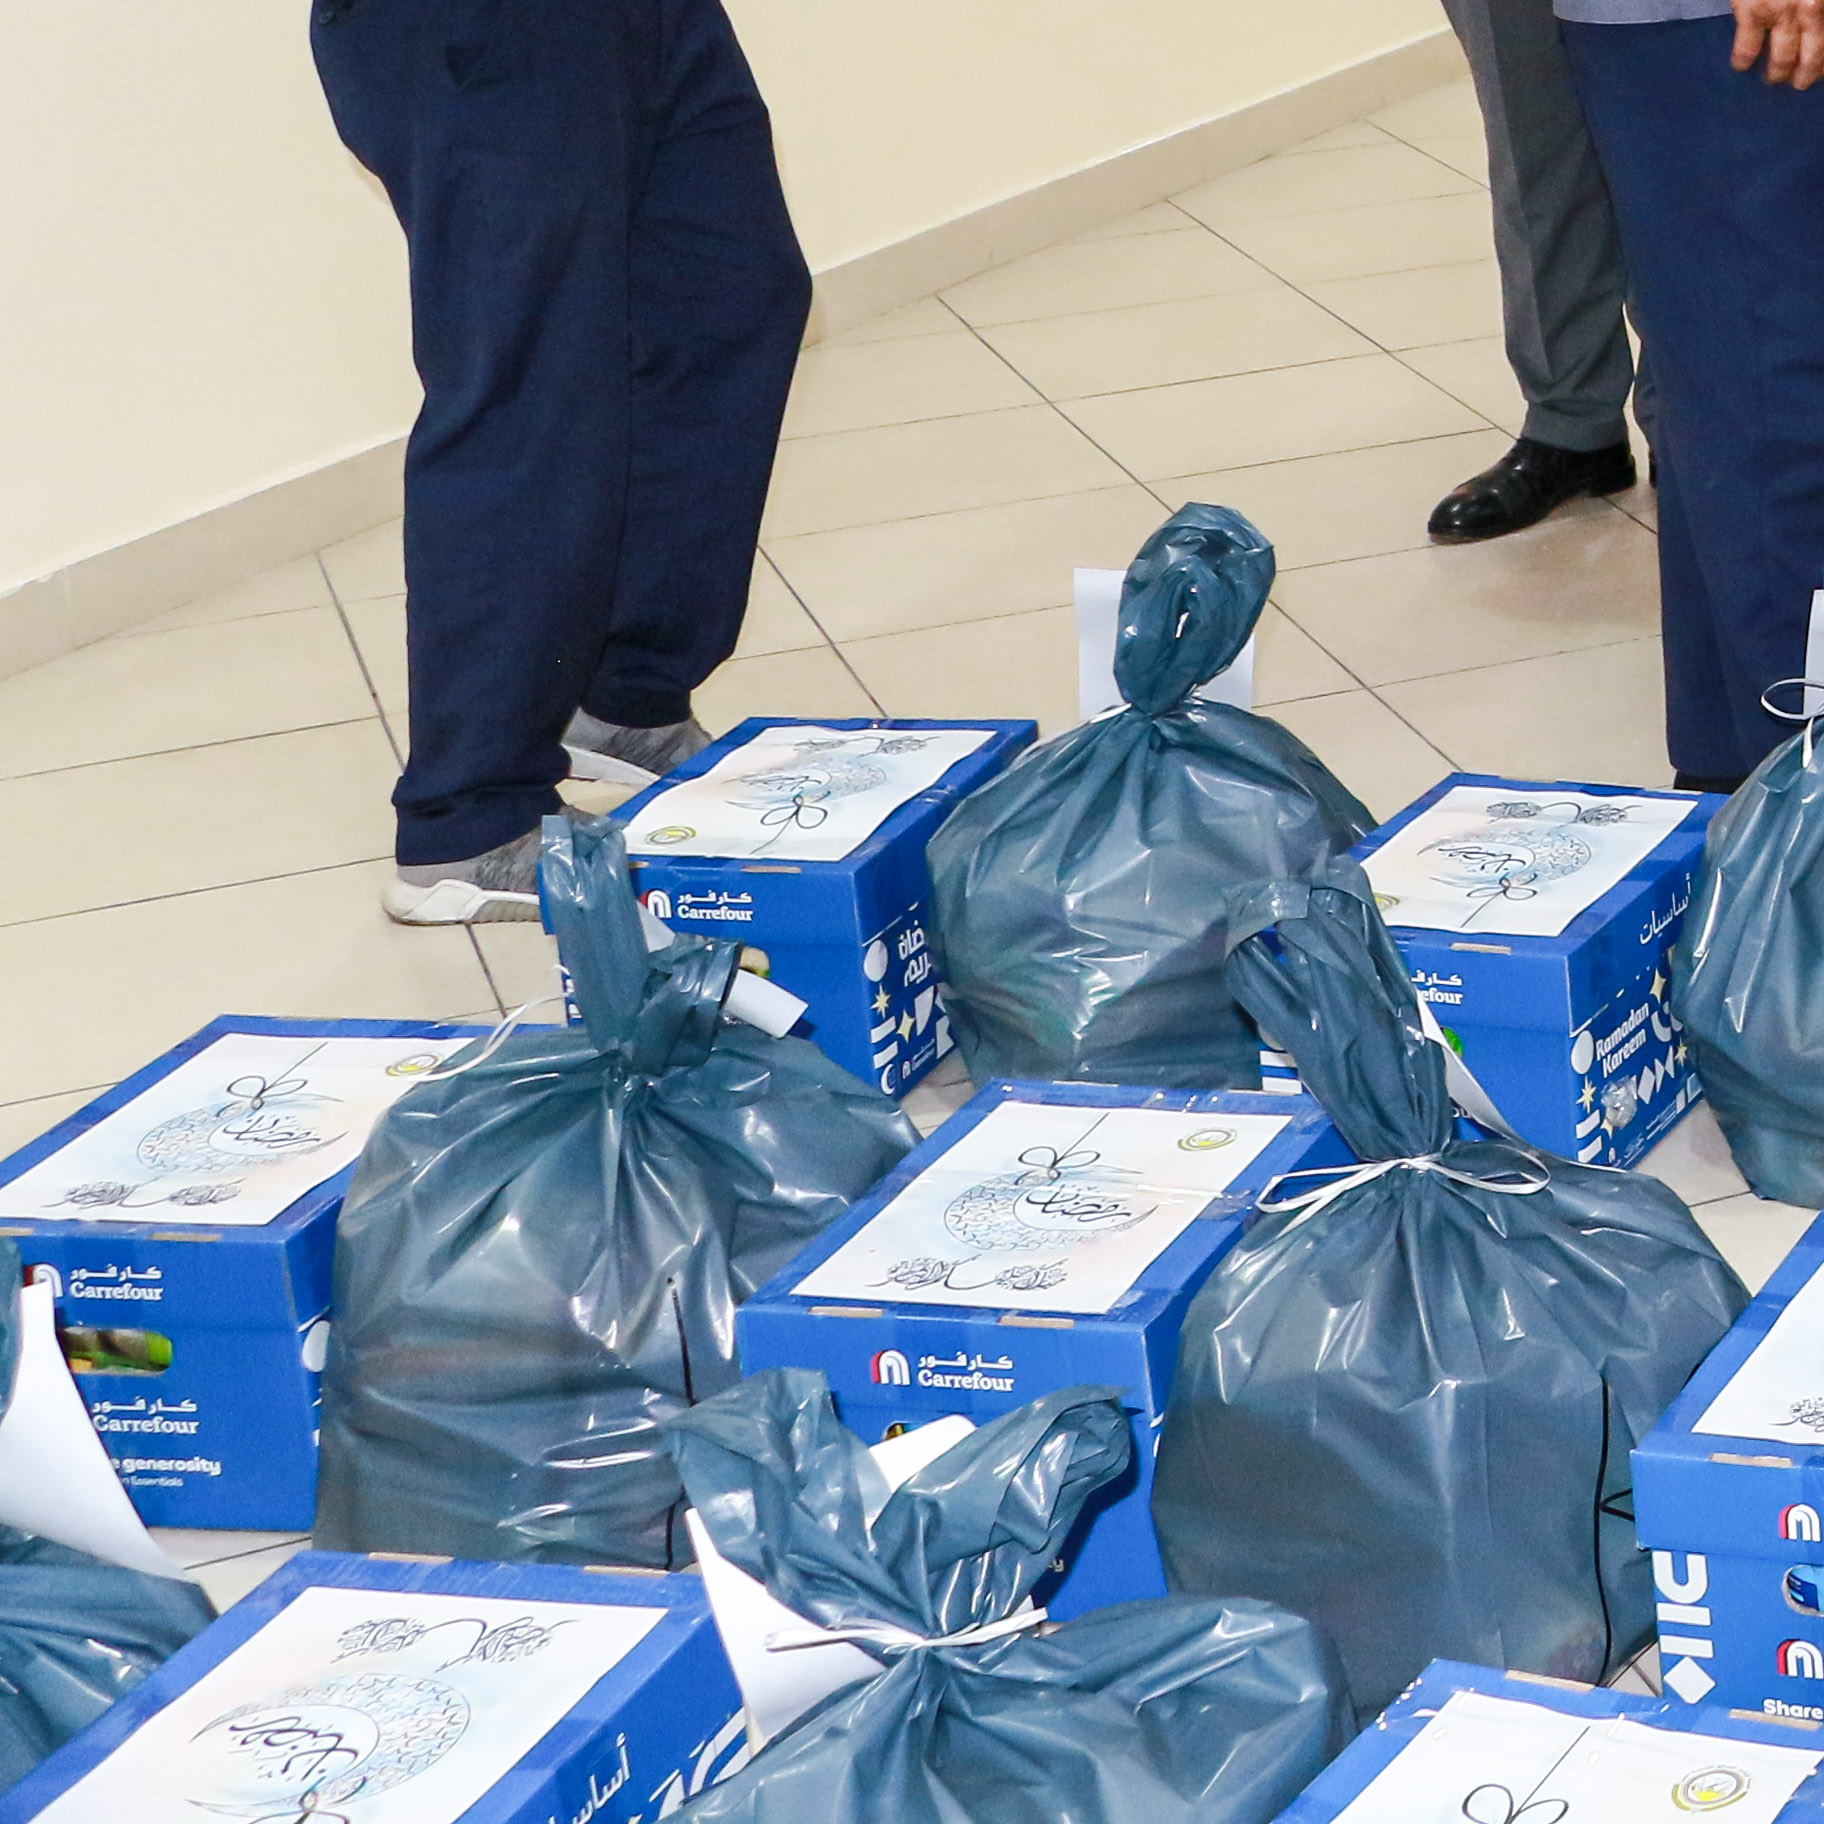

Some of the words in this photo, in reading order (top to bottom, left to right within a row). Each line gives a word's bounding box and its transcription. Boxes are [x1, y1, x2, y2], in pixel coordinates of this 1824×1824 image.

[677, 889, 752, 904] كارفور
[677, 905, 753, 921] Carrefour
[1640, 873, 1691, 945] أساسيات
[1596, 1003, 1649, 1061] Ramadan
[1602, 1028, 1647, 1079] Kareem
[70, 1263, 163, 1281] كارفور
[69, 1282, 164, 1301] Carrefour
[917, 1351, 1013, 1371] كارفور
[917, 1369, 1015, 1392] Carrefour
[91, 1396, 198, 1415] كارفور
[91, 1415, 200, 1435] Carrefour
[121, 1456, 223, 1477] generosity
[1762, 1697, 1824, 1721] Share
